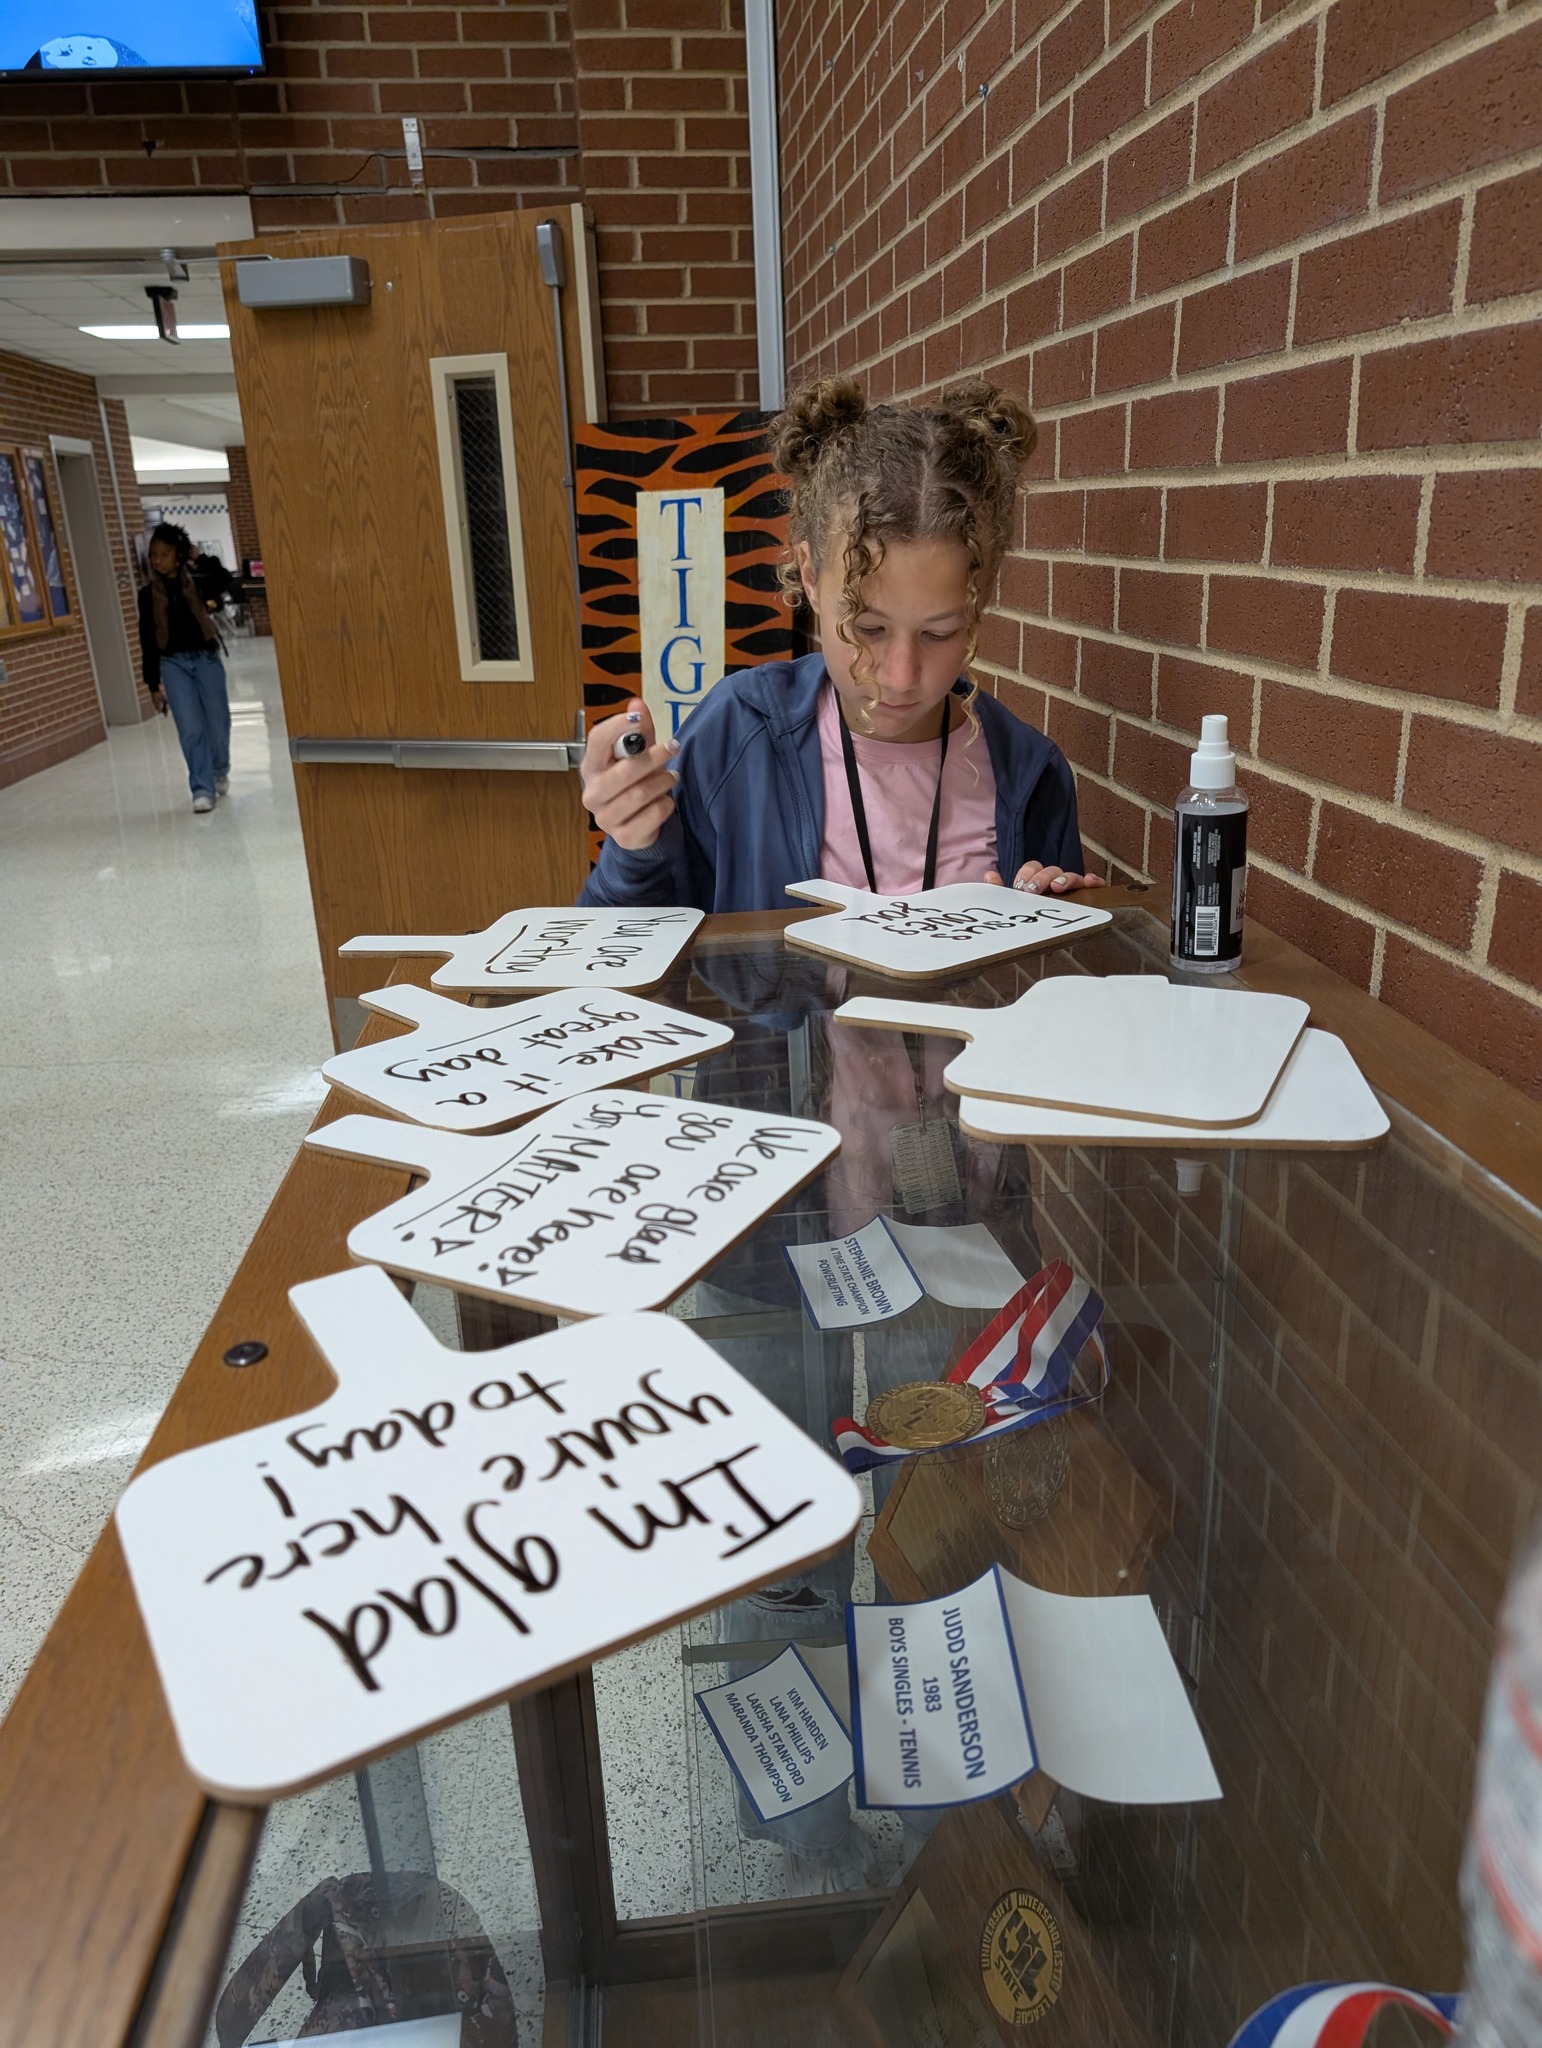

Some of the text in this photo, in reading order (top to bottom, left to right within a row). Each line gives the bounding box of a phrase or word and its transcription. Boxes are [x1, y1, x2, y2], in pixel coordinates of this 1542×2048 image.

[584, 942, 644, 972] are
[930, 909, 1092, 942] Jesus
[384, 1001, 641, 1083] great day
[435, 1022, 709, 1107] Make it a
[664, 1111, 734, 1153] you
[588, 1163, 662, 1206] are
[686, 1161, 758, 1202] are
[605, 1203, 699, 1266] glad
[818, 1259, 848, 1307] POWERLIFTING
[832, 1250, 845, 1264] TIME
[839, 1265, 853, 1282] STATE
[847, 1282, 871, 1315] CHAMPION
[844, 1237, 894, 1314] STEPHANIE BROWN
[469, 1370, 567, 1415] to
[586, 1443, 814, 1561] I'm
[205, 1493, 441, 1591] here
[301, 1499, 561, 1694] glad
[888, 1616, 907, 1653] BOYS
[892, 1655, 914, 1716] SINGLES
[922, 1675, 942, 1714] 1983
[942, 1606, 986, 1781] JUDD SANDERSON
[725, 1692, 794, 1804] MARANDA THOMPSON
[746, 1693, 806, 1787] LAKISHA STANFORD
[768, 1695, 815, 1766] LANA PHILLIPS
[786, 1686, 830, 1751] KIM HARDEN
[897, 1726, 922, 1789] TENNIS
[981, 1895, 1012, 1971] UNIVERSITY
[994, 1953, 1023, 2002] STATE
